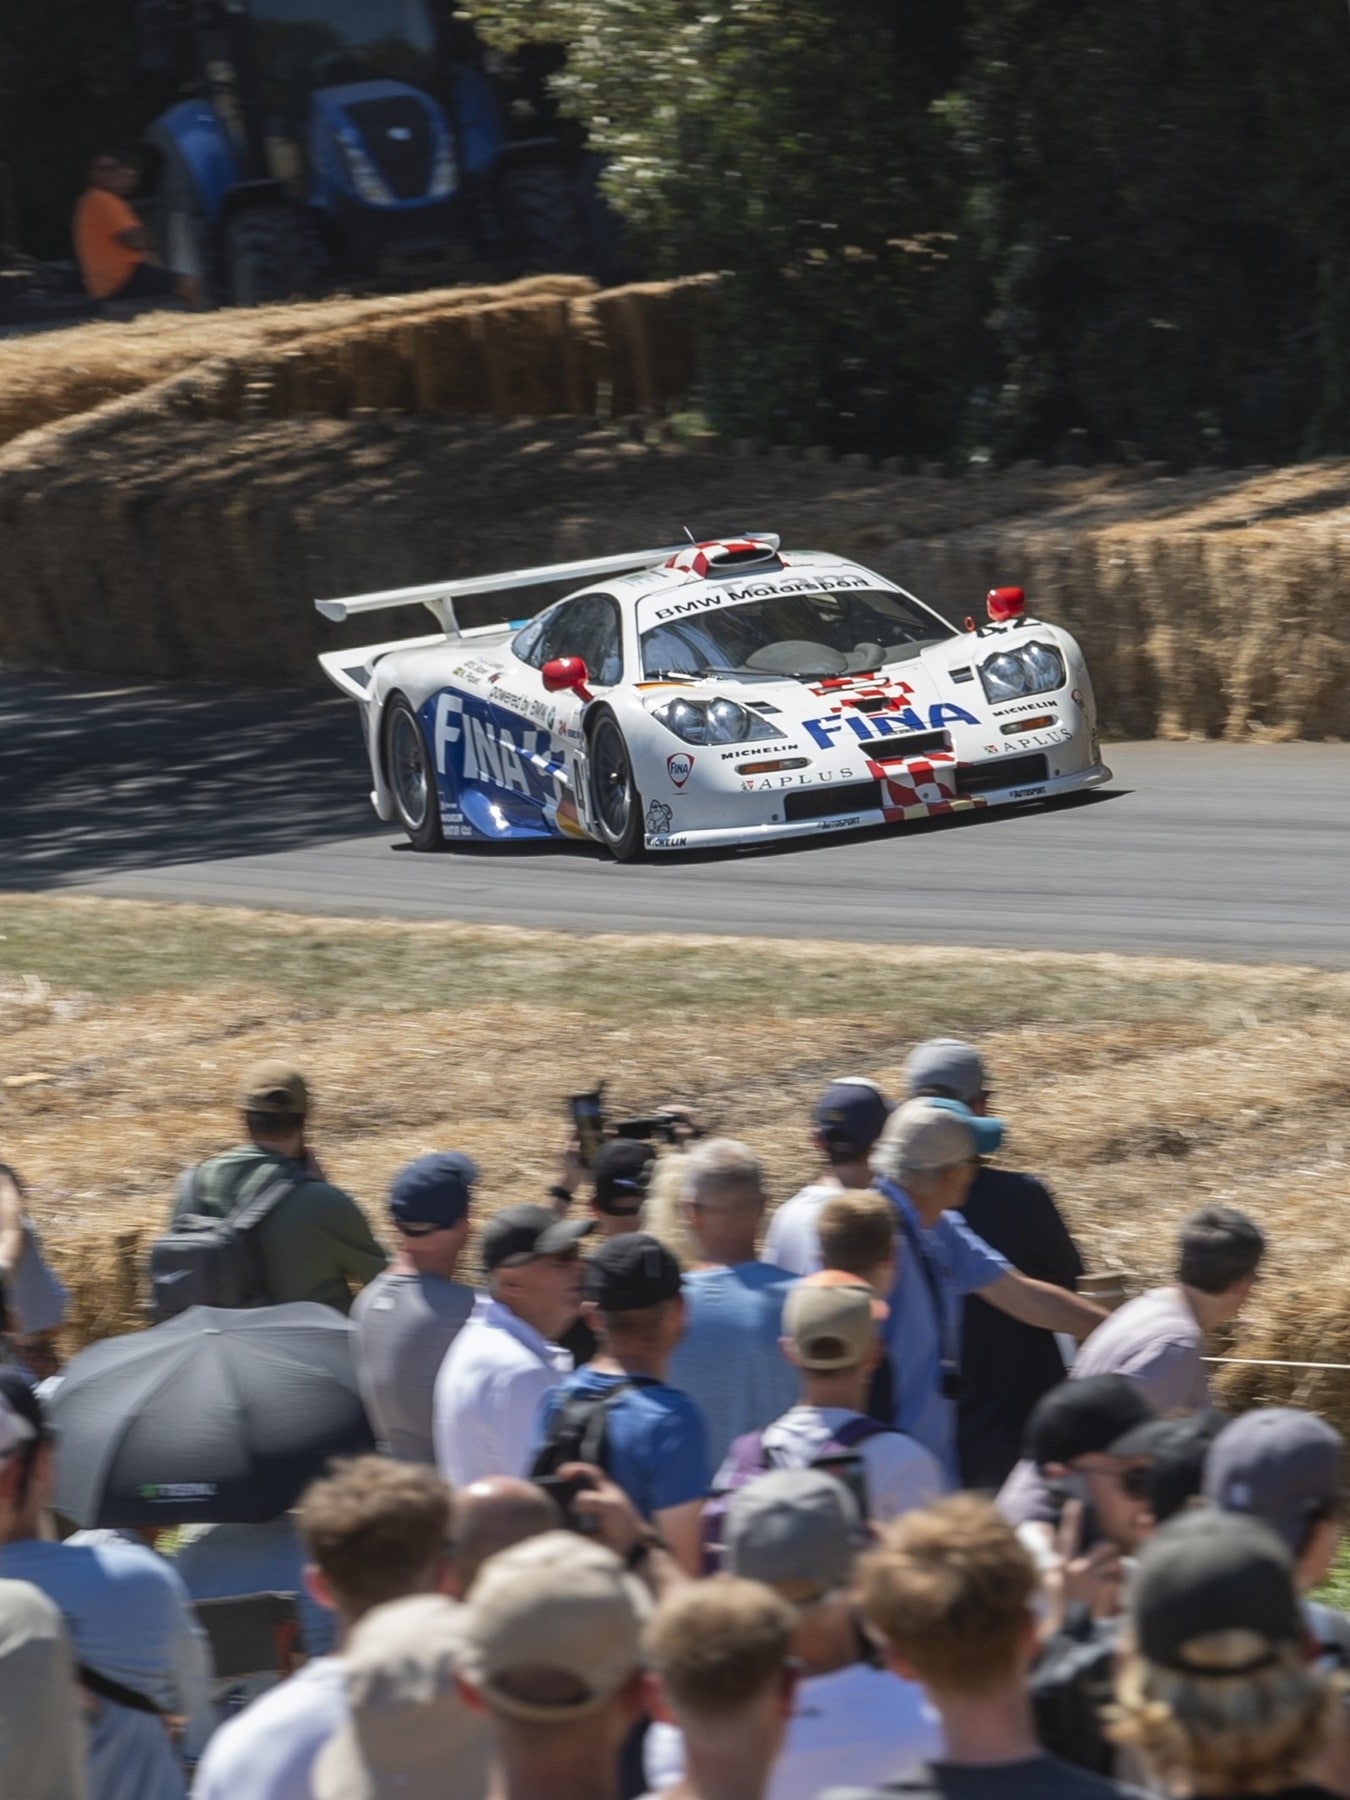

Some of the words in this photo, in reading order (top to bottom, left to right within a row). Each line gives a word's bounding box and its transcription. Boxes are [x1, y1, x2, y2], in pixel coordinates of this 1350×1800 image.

[655, 595, 721, 619] BMW
[728, 579, 871, 601] Motorsport
[489, 686, 522, 709] powered
[530, 699, 548, 721] BMW
[992, 700, 1058, 716] MICHELIN
[802, 703, 981, 750] FINA
[435, 692, 531, 797] FINA
[721, 744, 798, 760] MICHELIN
[1004, 728, 1073, 752] APLUS
[670, 762, 688, 774] FINA
[759, 768, 853, 790] APLUS
